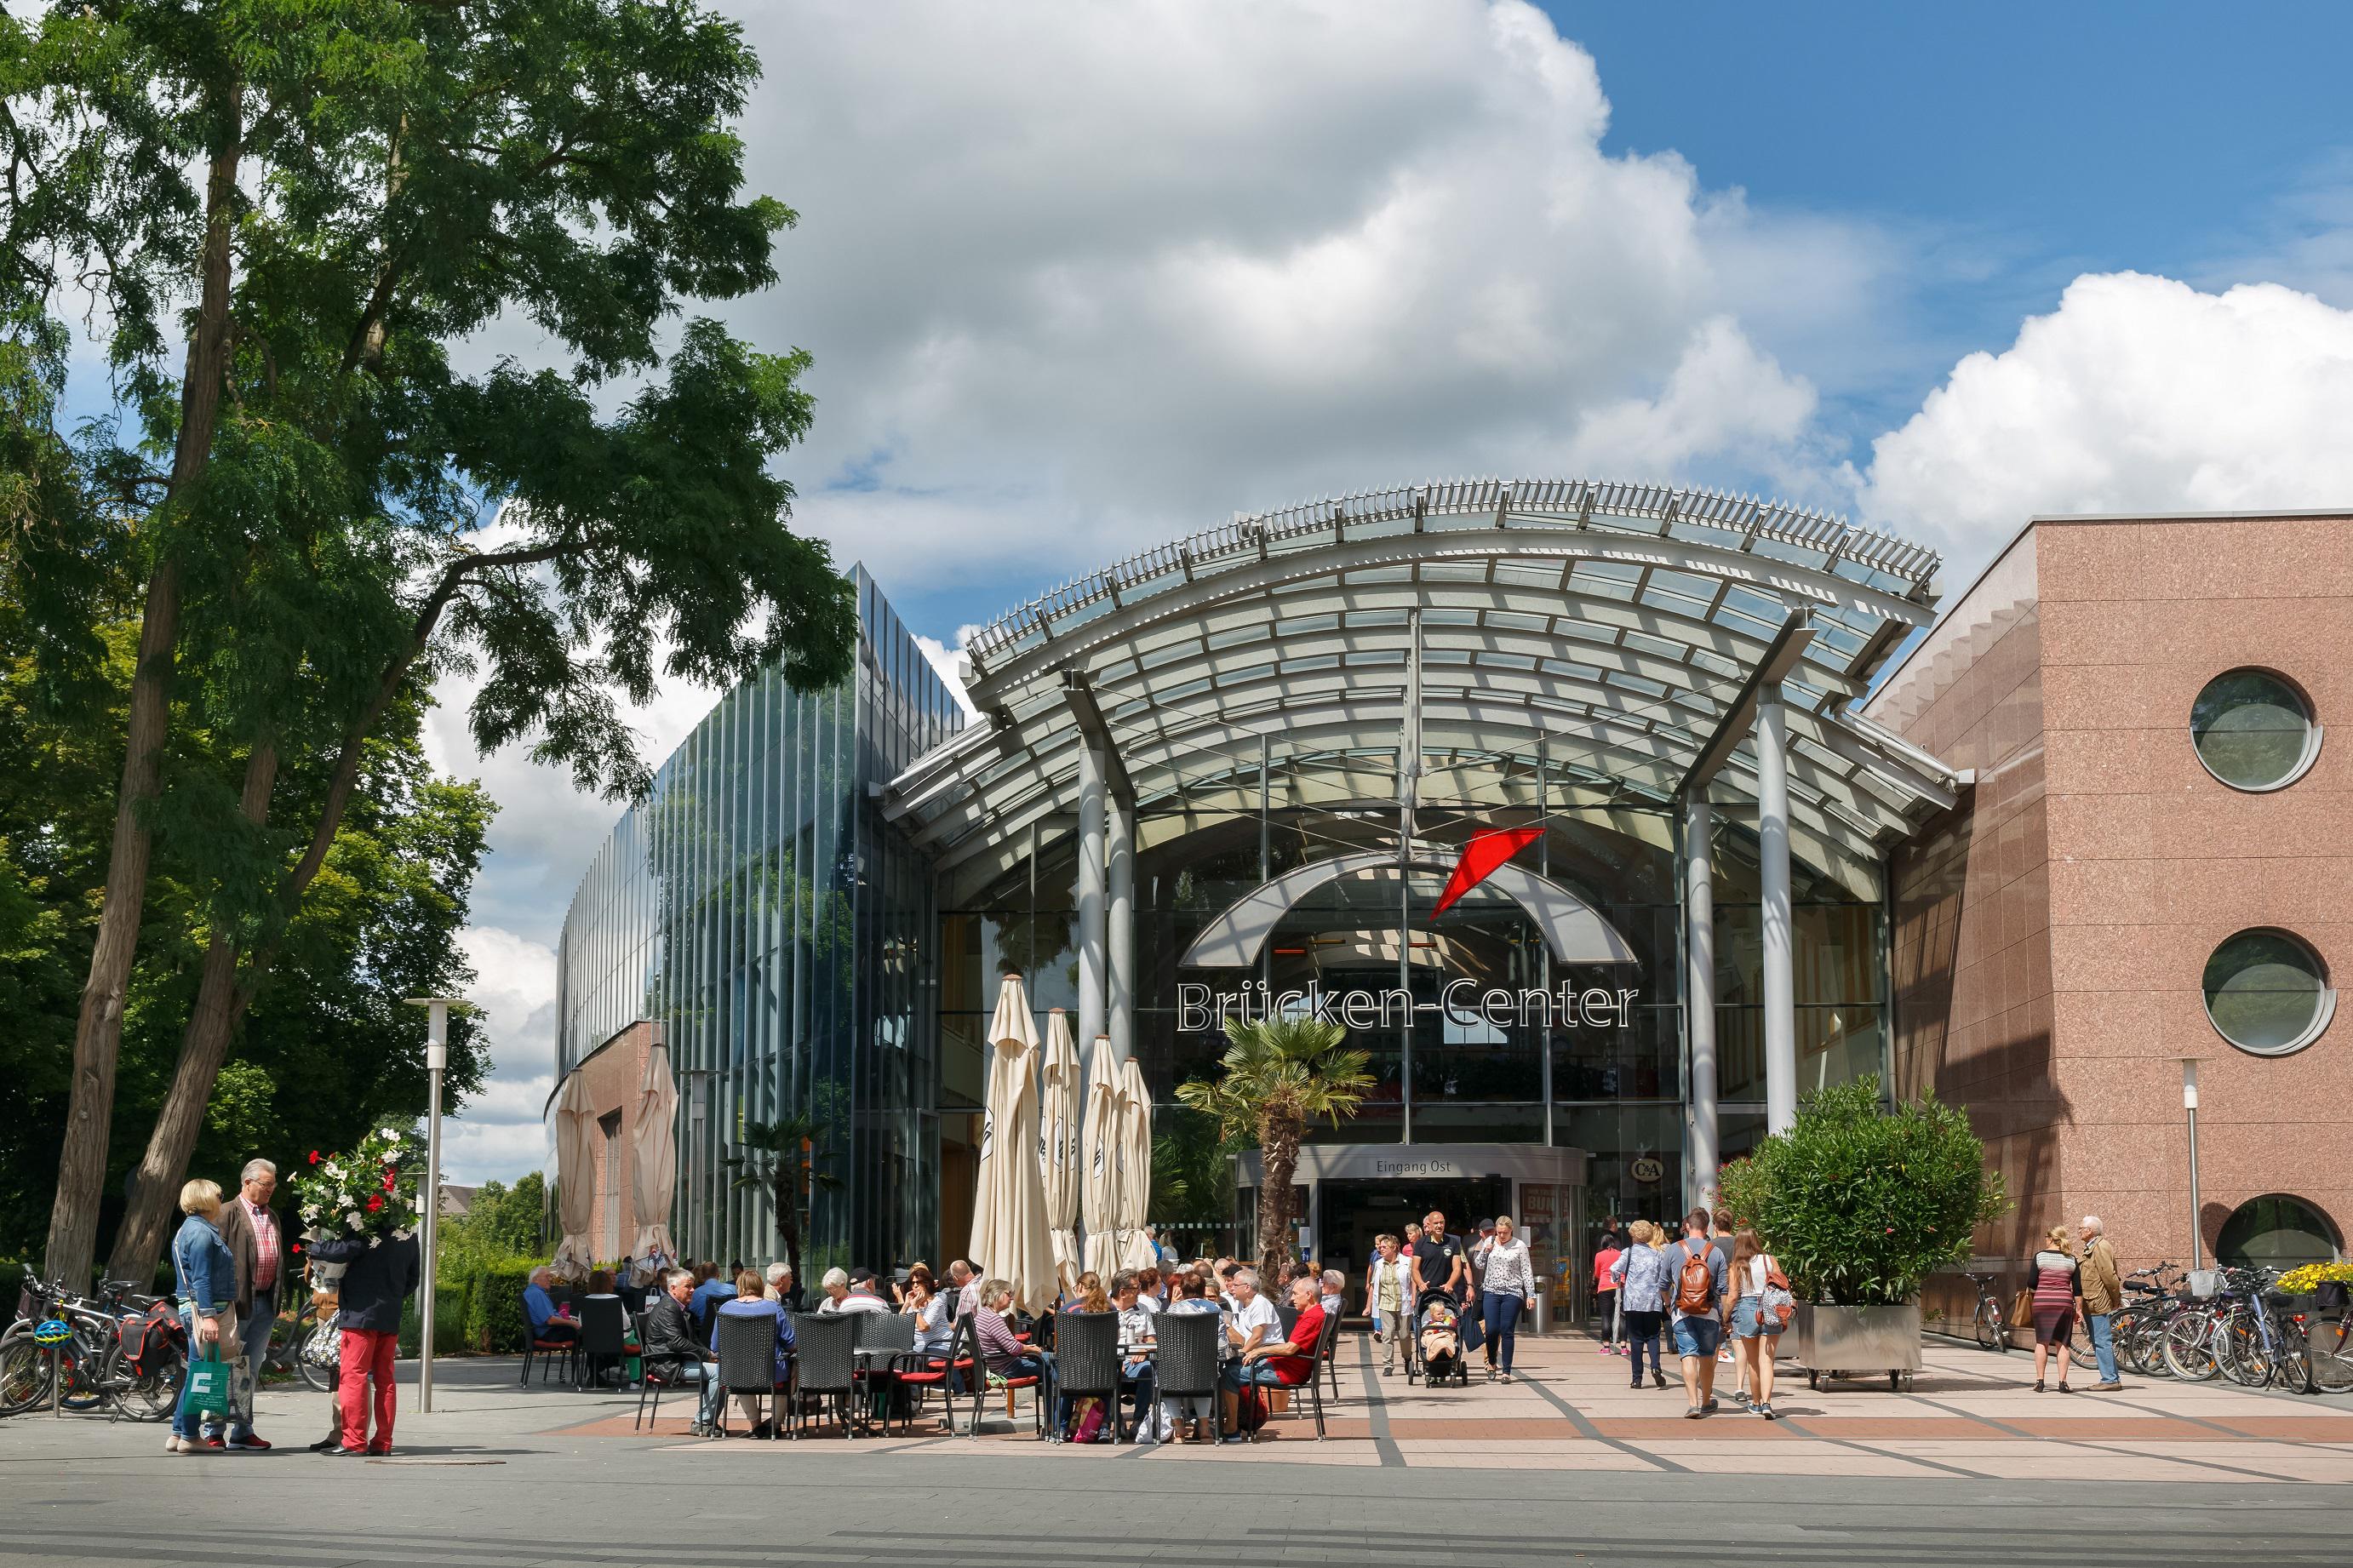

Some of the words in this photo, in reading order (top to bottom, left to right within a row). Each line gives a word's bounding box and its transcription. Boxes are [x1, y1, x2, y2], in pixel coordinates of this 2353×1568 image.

[1176, 978, 1640, 1032] Brücken-Center
[1377, 1160, 1427, 1175] Eingang
[1430, 1159, 1451, 1172] Ost
[1635, 1162, 1661, 1176] C&A
